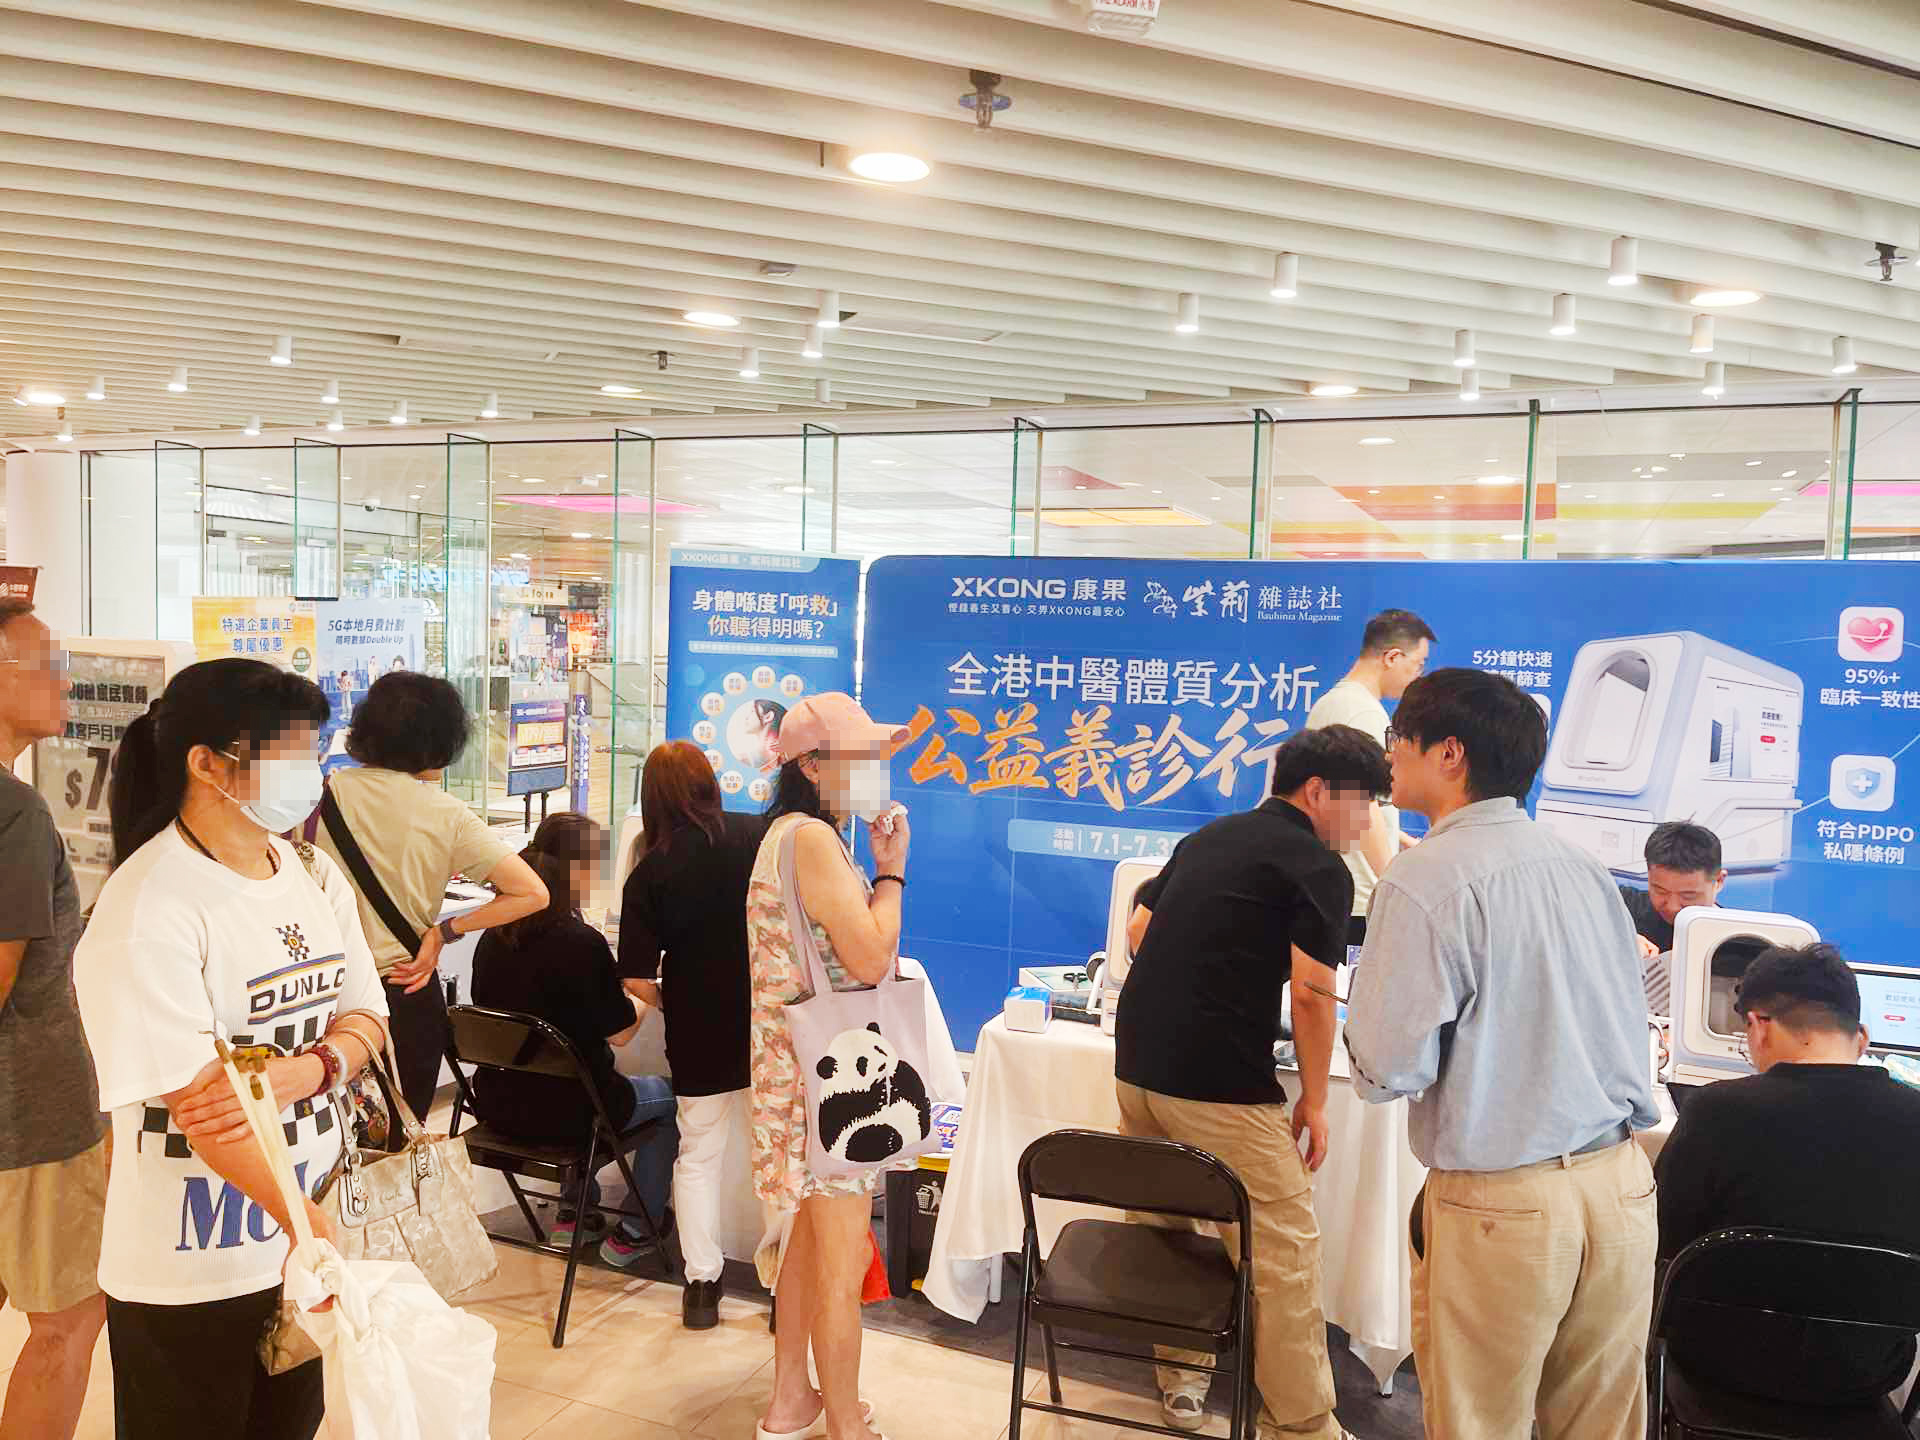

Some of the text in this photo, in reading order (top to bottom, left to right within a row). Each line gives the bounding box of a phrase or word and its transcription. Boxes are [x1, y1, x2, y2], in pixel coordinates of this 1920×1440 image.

[952, 577, 1127, 601] XKONG 康果
[1257, 586, 1343, 610] 雜誌社
[1257, 611, 1343, 623] Bauhinia Magazine
[1472, 649, 1552, 668] 5分鐘快速
[947, 651, 1320, 713] 全港中醫體質分析
[1844, 668, 1901, 685] 95%+
[1820, 688, 1920, 709] 臨床一致性
[892, 701, 1291, 812] 公益義診行
[1816, 819, 1915, 842] 符合PDPO
[1089, 831, 1179, 858] 7.1-7.3
[1823, 842, 1905, 865] 私隱條例
